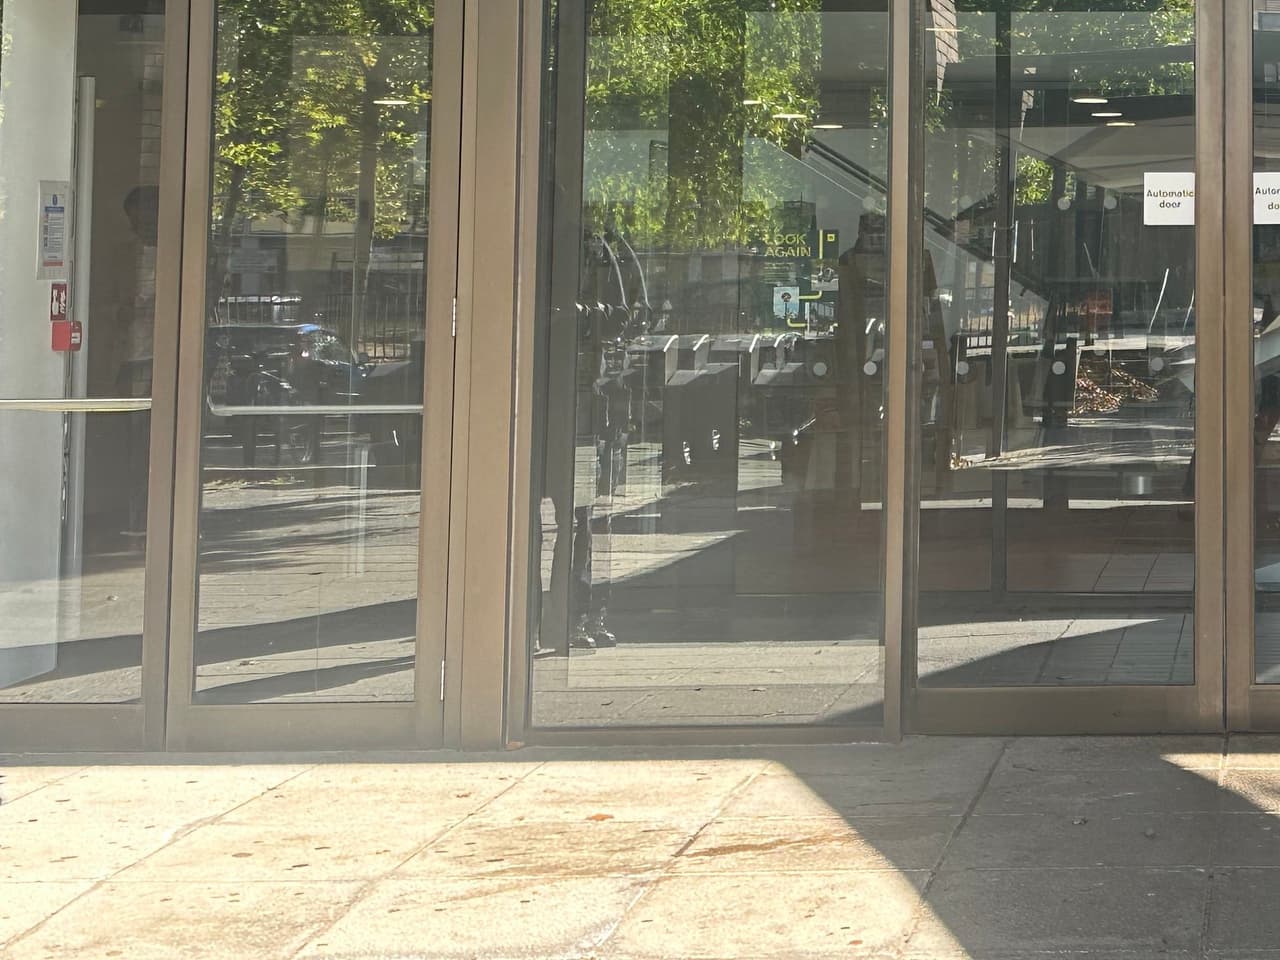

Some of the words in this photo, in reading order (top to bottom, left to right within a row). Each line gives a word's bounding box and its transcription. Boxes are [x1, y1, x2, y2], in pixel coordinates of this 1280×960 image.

[1146, 189, 1195, 199] Automatic
[1159, 201, 1181, 209] door
[765, 246, 811, 257] AGAIN
